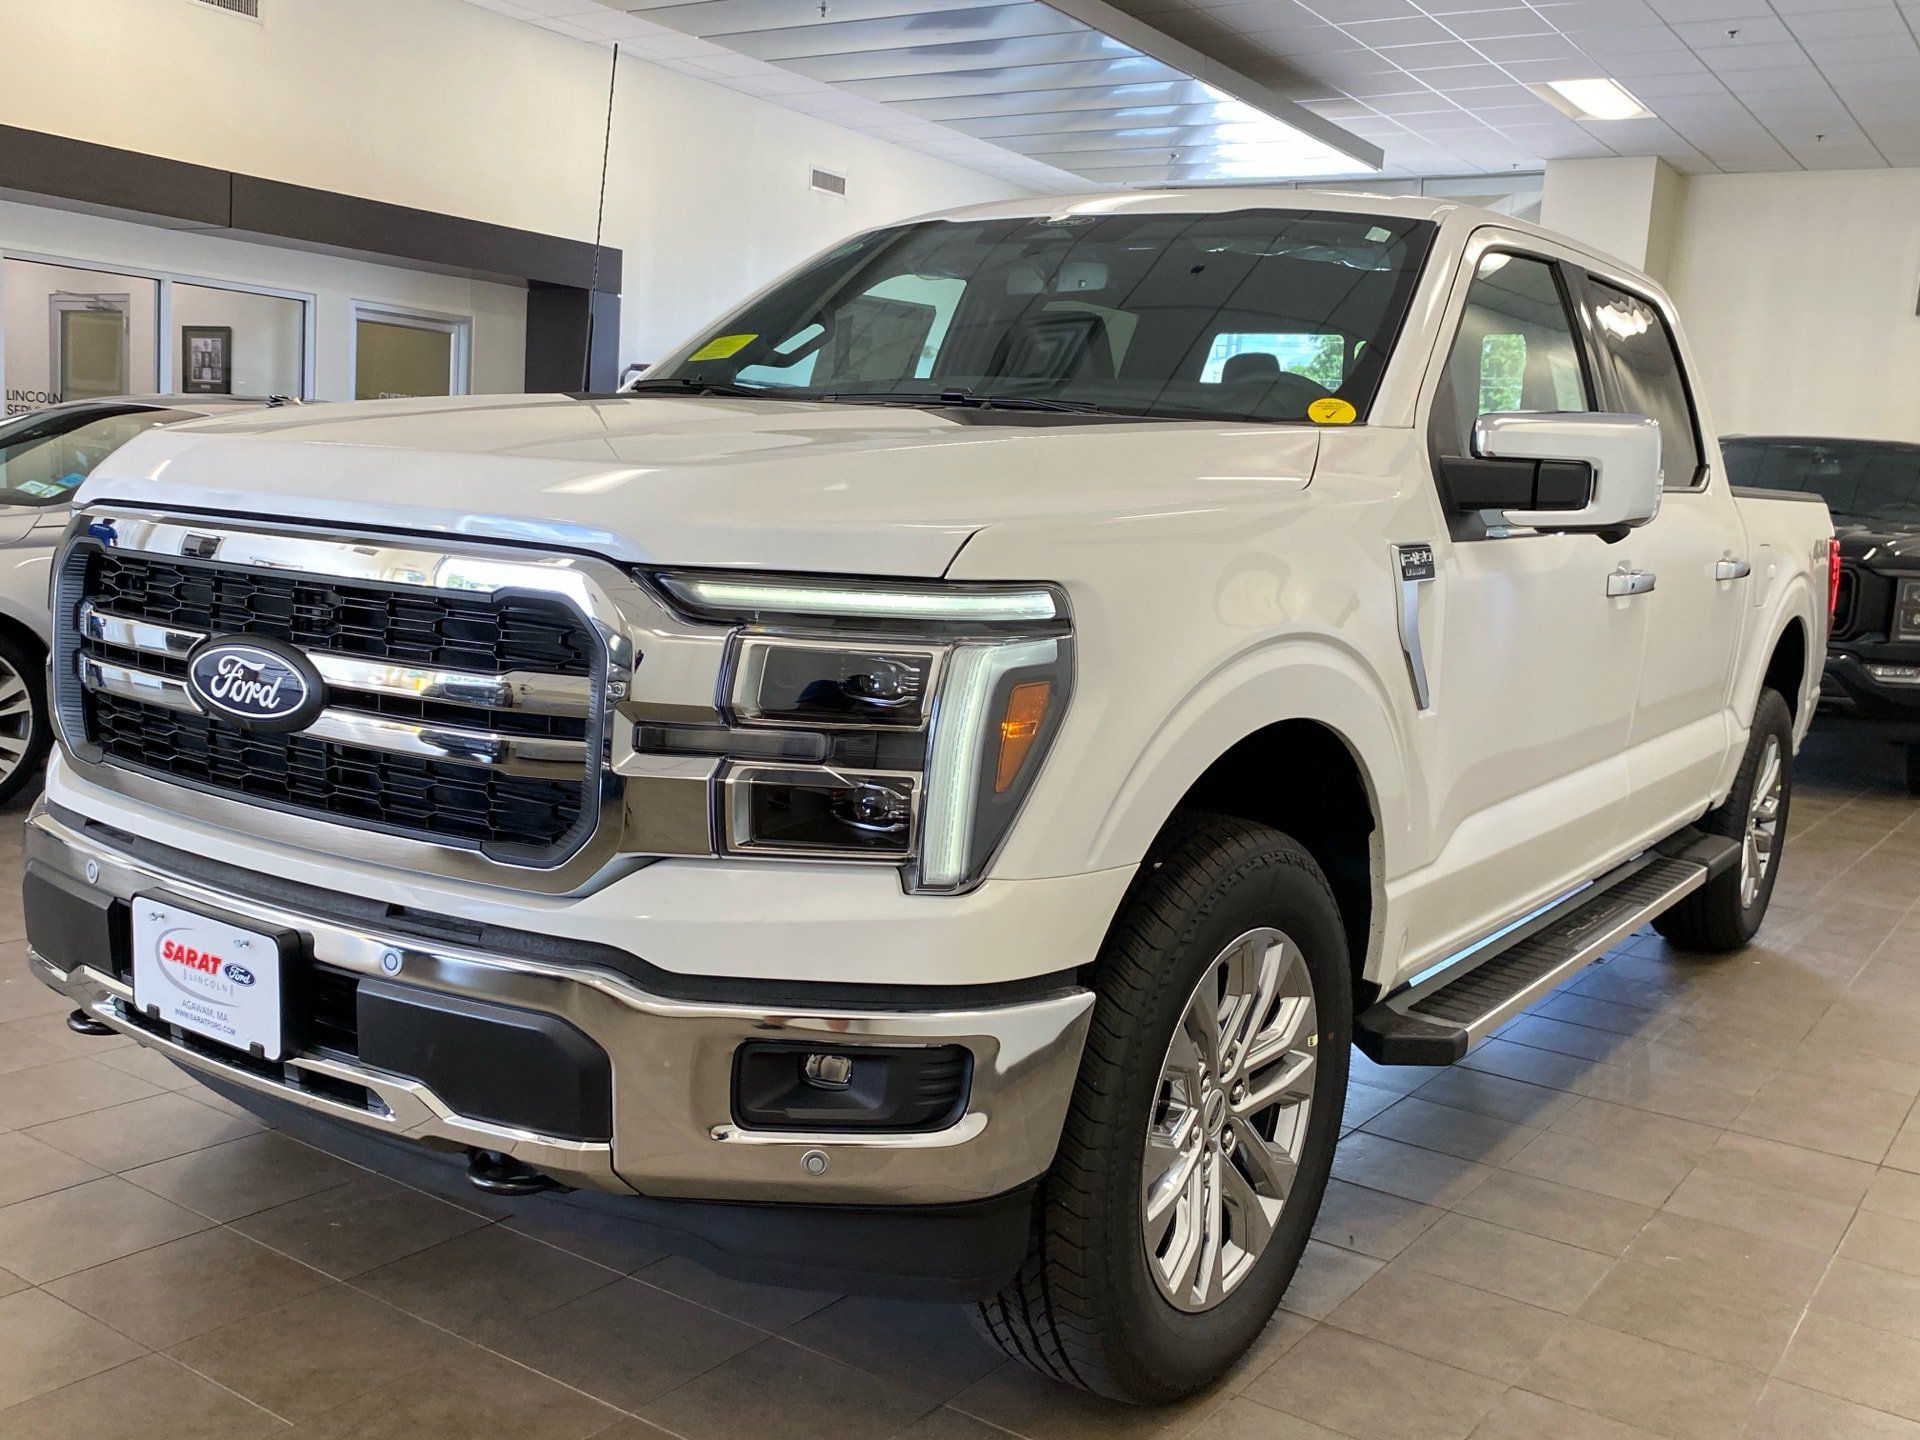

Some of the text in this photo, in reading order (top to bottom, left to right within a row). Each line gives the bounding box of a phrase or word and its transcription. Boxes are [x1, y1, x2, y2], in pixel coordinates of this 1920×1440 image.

[7, 389, 63, 404] LINCOLN
[210, 655, 283, 709] Ford
[162, 939, 222, 975] SARAT
[189, 972, 228, 993] LINCOLN
[228, 964, 252, 985] Ford
[216, 1010, 229, 1022] MA
